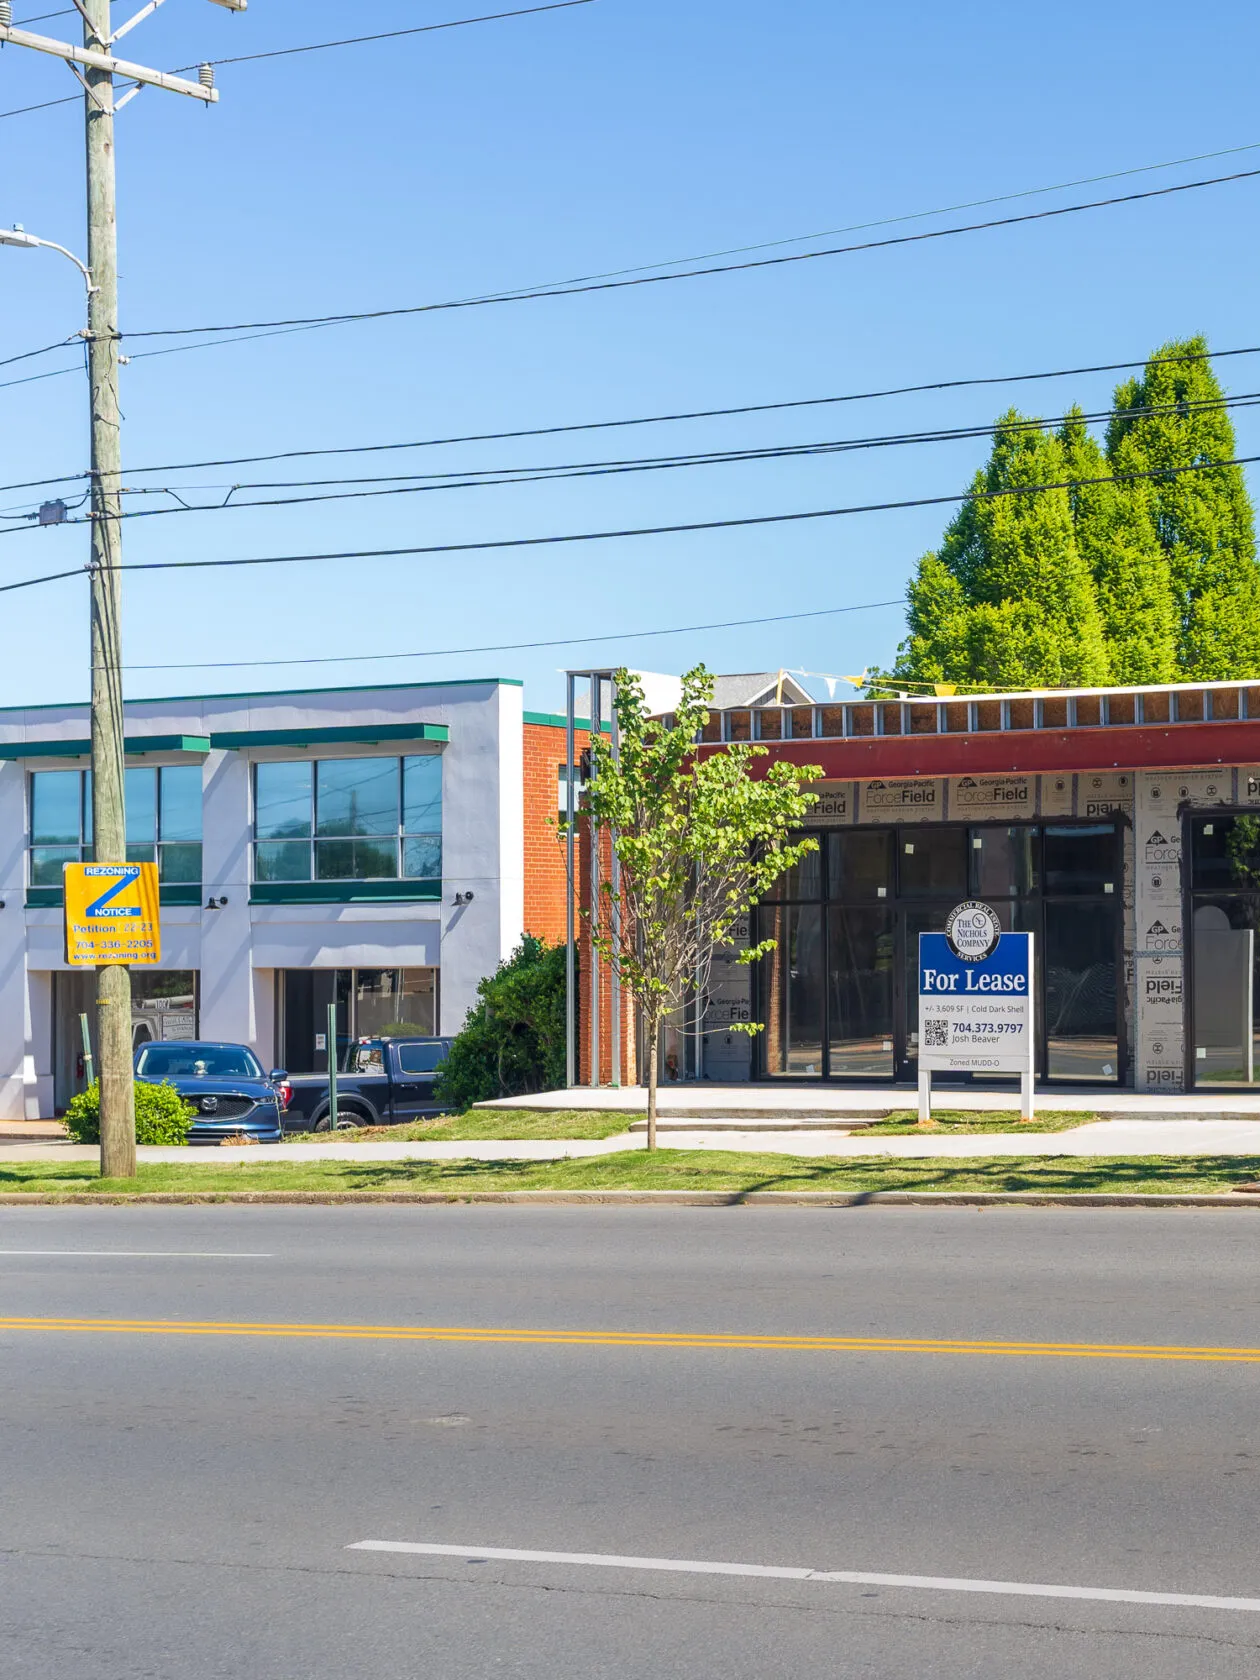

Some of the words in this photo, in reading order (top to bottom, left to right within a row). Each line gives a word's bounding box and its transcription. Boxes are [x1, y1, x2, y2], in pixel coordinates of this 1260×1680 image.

[866, 789, 935, 804] ForceField
[956, 787, 1028, 802] ForceField
[85, 867, 139, 875] REZONING
[94, 908, 132, 916] NOTICE
[946, 902, 975, 937] COMMERCIAL
[956, 918, 971, 928] THE
[73, 924, 116, 933] Petition
[957, 929, 988, 938] NICHOLS
[956, 938, 990, 948] COMPANY
[956, 951, 988, 962] SERVICES
[923, 969, 959, 991] For
[965, 969, 1025, 991] Lease
[936, 1004, 955, 1014] 3,609
[956, 1004, 965, 1013] SF
[971, 1005, 987, 1014] Cold
[989, 1005, 1006, 1014] Dark
[1007, 1005, 1024, 1014] Shell
[952, 1023, 1023, 1034] 704.373.9797
[951, 1035, 970, 1044] Josh
[971, 1035, 1000, 1044] Beaver
[949, 1059, 970, 1067] Zoned
